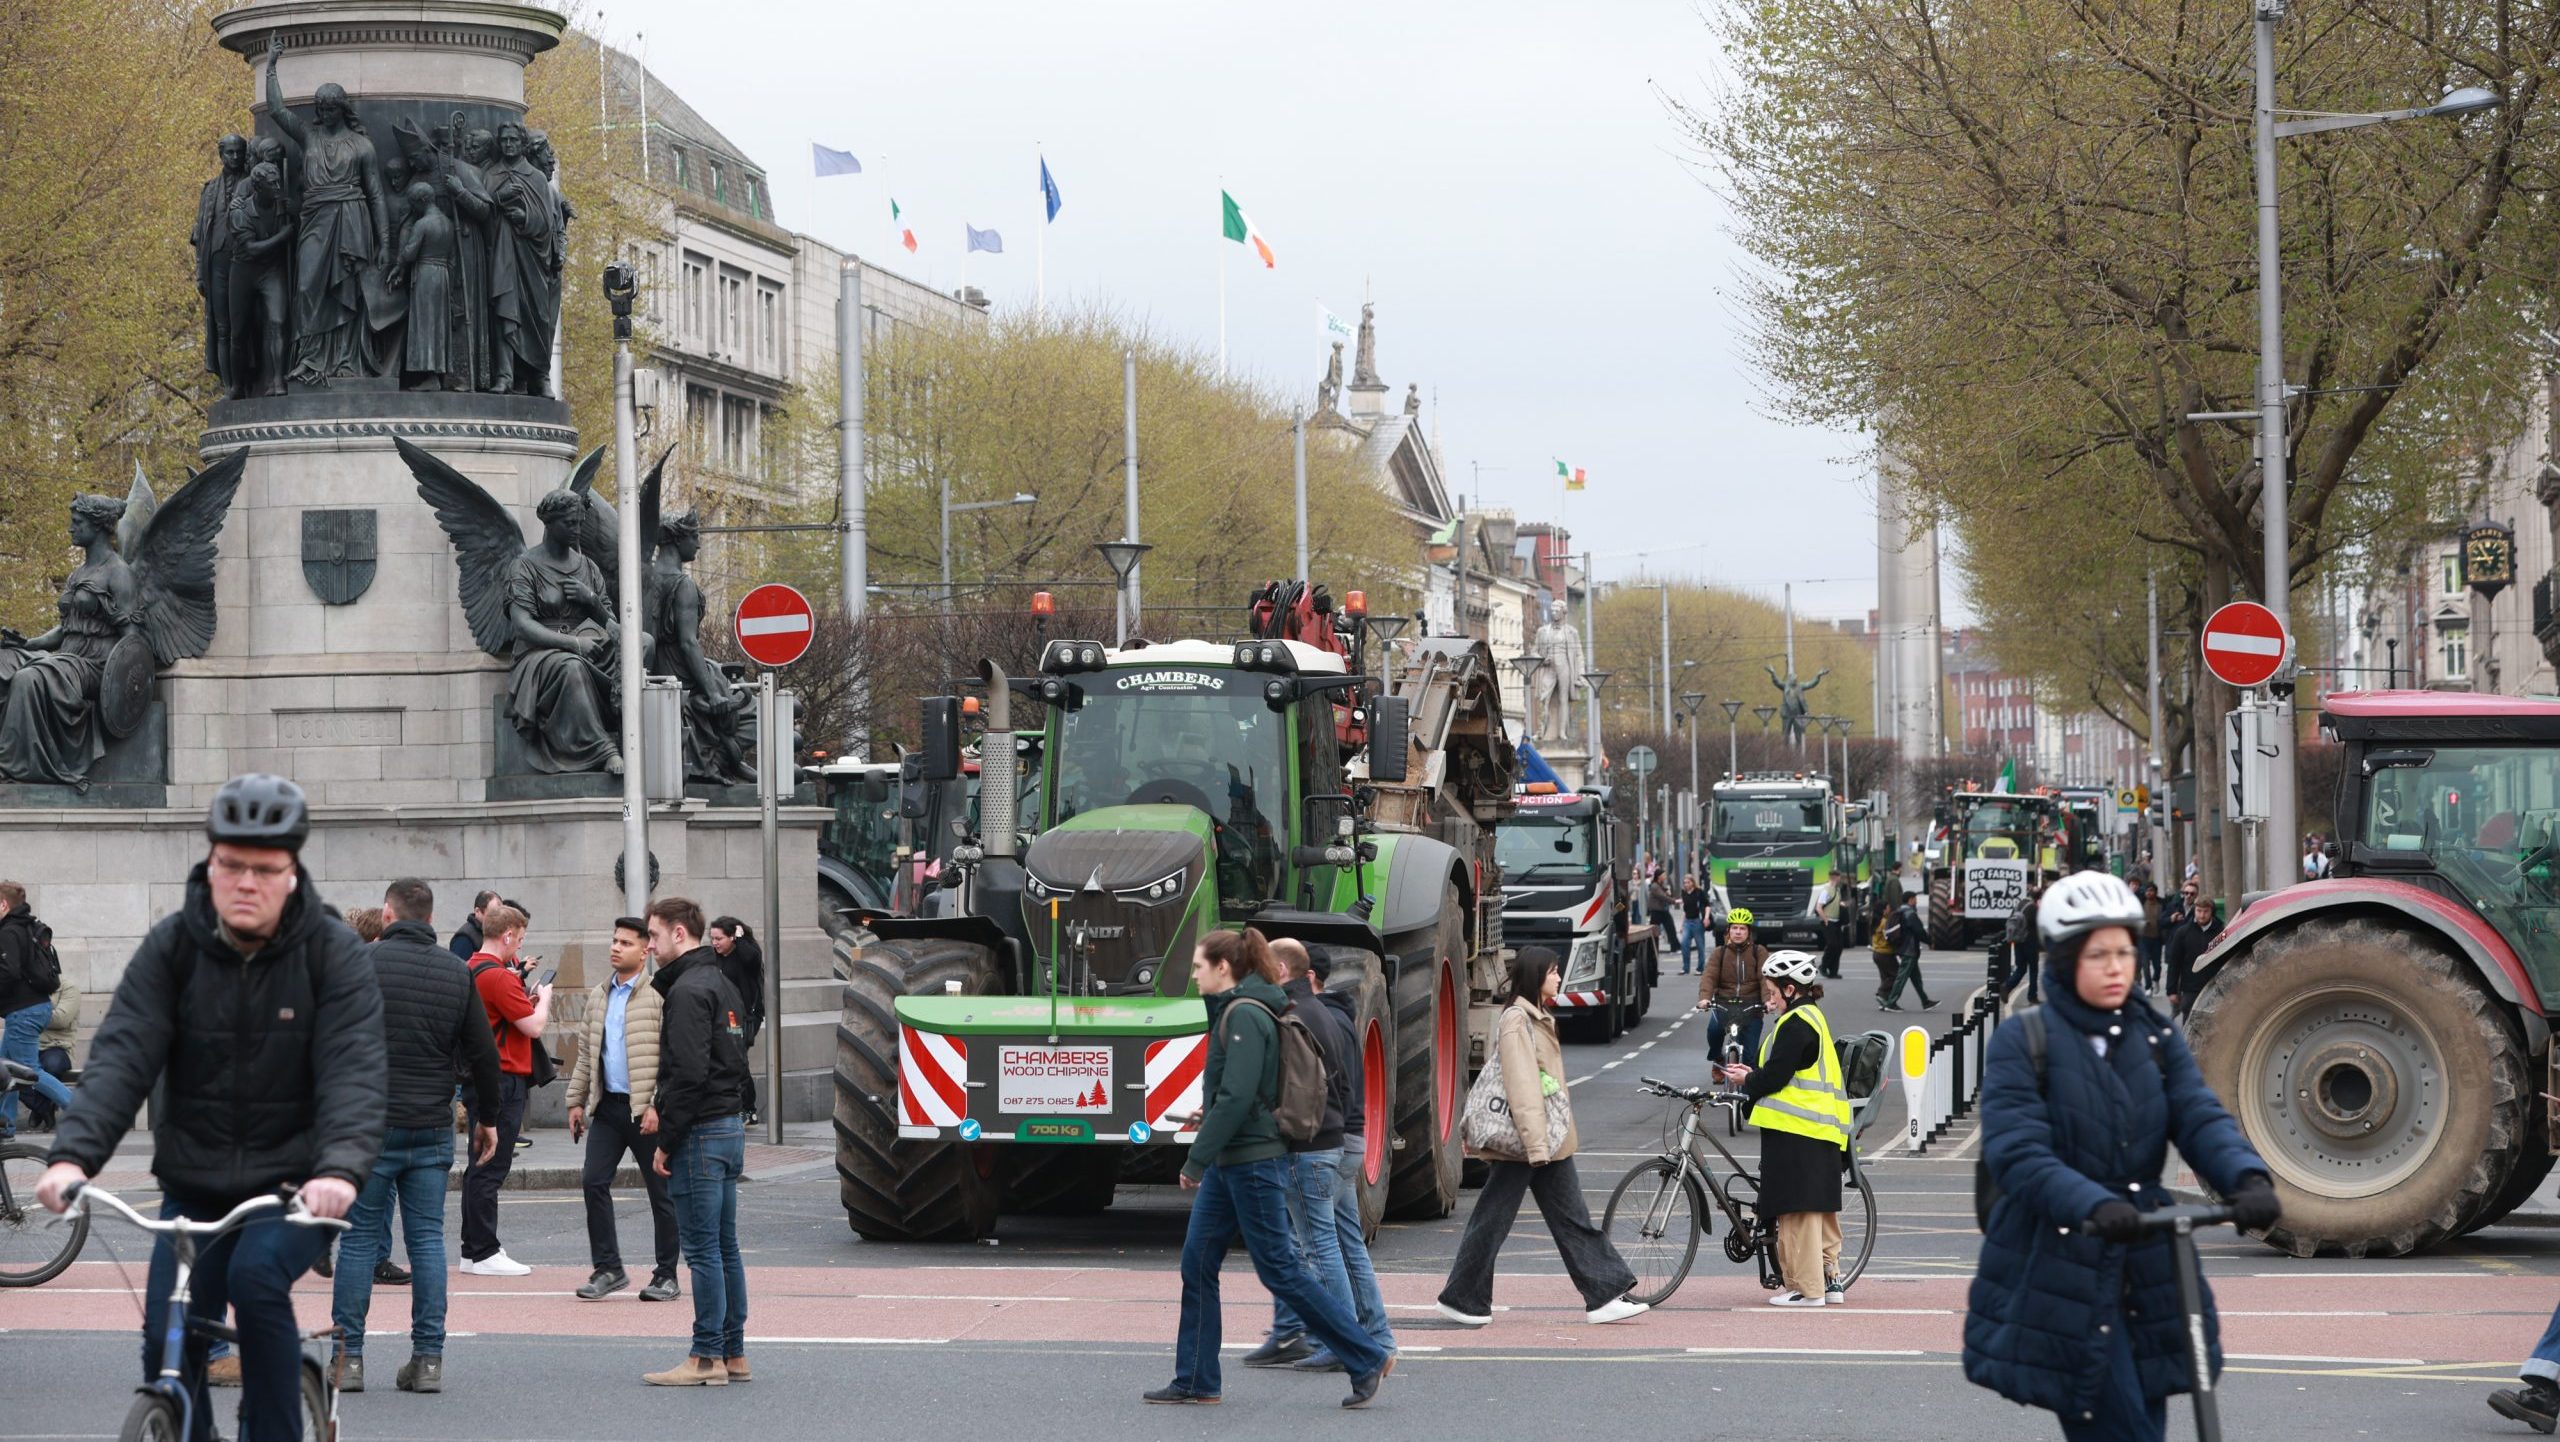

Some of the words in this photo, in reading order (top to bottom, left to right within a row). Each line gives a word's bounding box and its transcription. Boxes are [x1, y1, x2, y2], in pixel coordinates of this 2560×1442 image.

[1116, 671, 1225, 690] CHAMBERS
[1737, 860, 1768, 868] FARRELLY
[1770, 860, 1800, 868] HAULAGE
[1970, 869, 1986, 880] NO
[1987, 868, 2021, 881] FARMS
[1970, 897, 1988, 908] NO
[1004, 1051, 1109, 1065] CHAMBERS
[1003, 1066, 1044, 1076] WOOD
[1047, 1066, 1109, 1077] CHIPPING
[1003, 1097, 1024, 1105] 087
[1026, 1097, 1044, 1105] 275
[1047, 1097, 1075, 1105] 0825
[1031, 1125, 1058, 1134] 700
[1061, 1125, 1080, 1136] Kg
